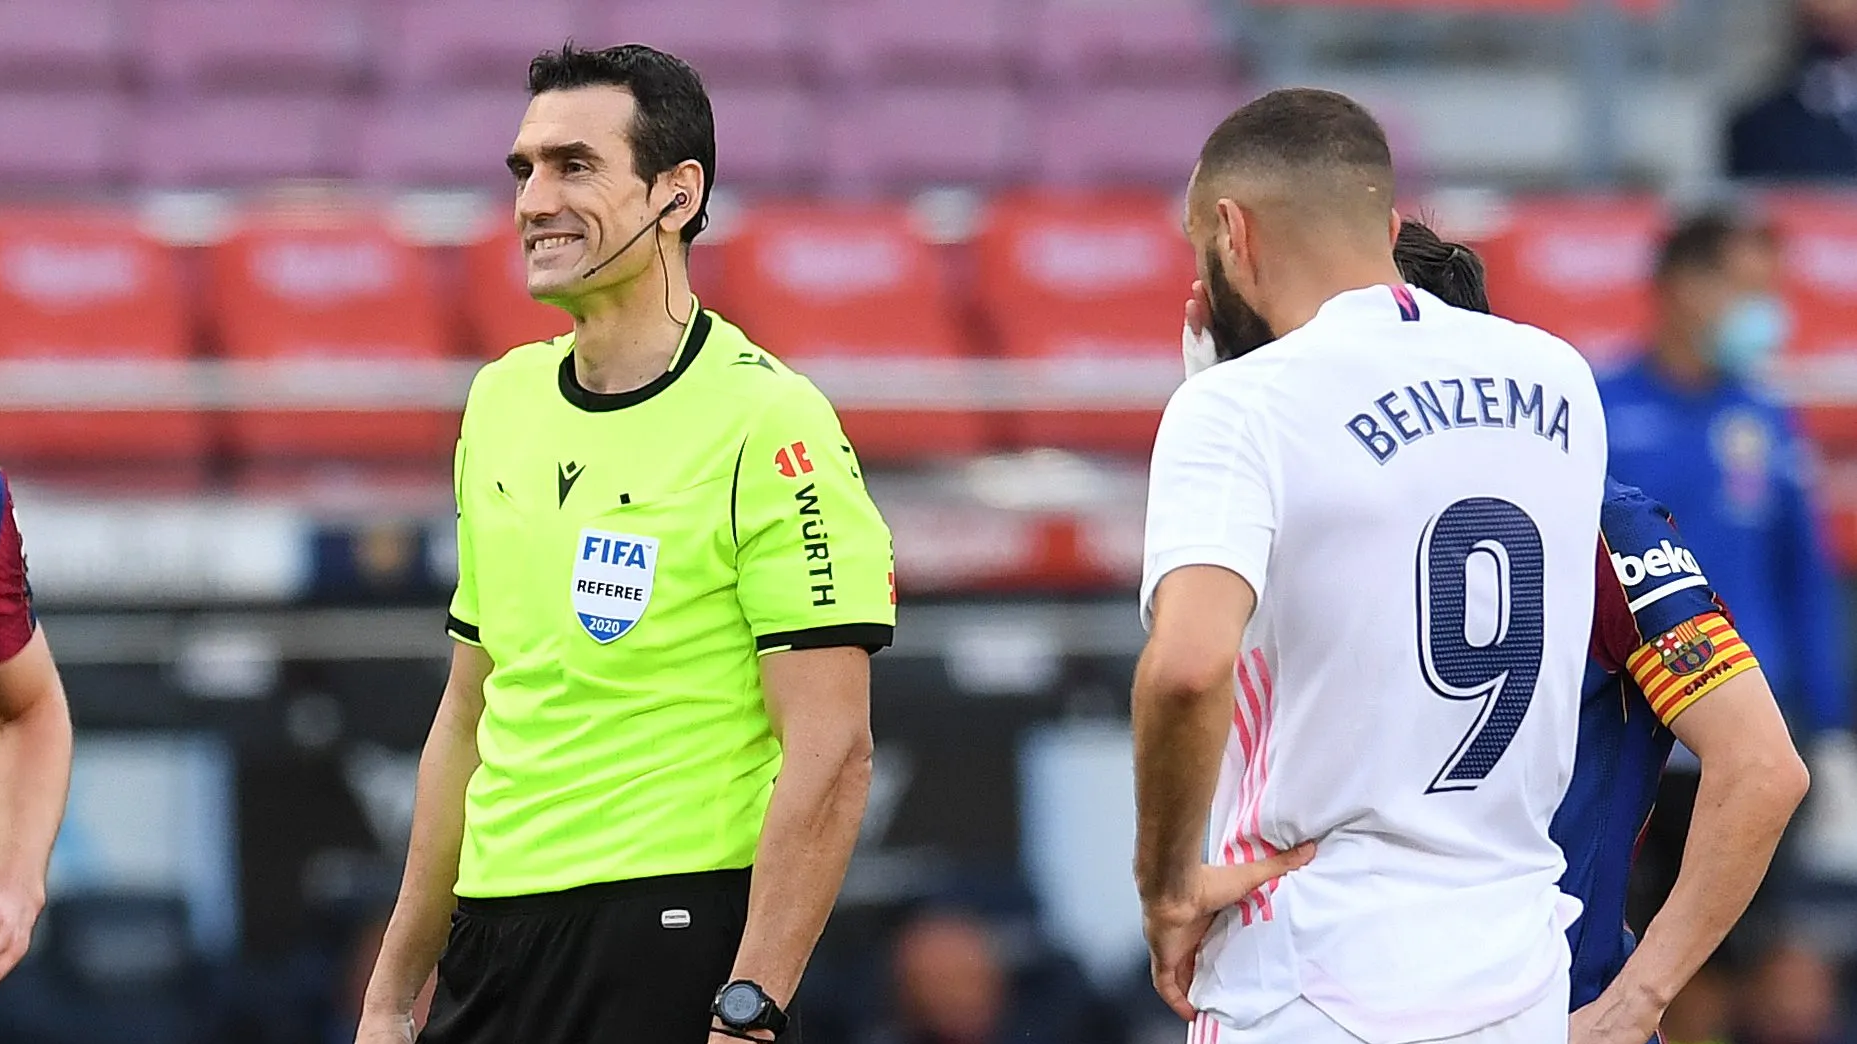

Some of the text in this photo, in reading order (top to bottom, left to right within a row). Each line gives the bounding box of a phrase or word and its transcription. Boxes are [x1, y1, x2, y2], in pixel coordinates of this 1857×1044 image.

[1344, 377, 1569, 466] BENZEMA
[582, 536, 646, 570] FIFA
[795, 483, 836, 606] WÜRTH
[1610, 540, 1702, 586] beko
[577, 579, 643, 601] REFEREE
[588, 617, 620, 634] 2020
[1415, 496, 1544, 794] 9
